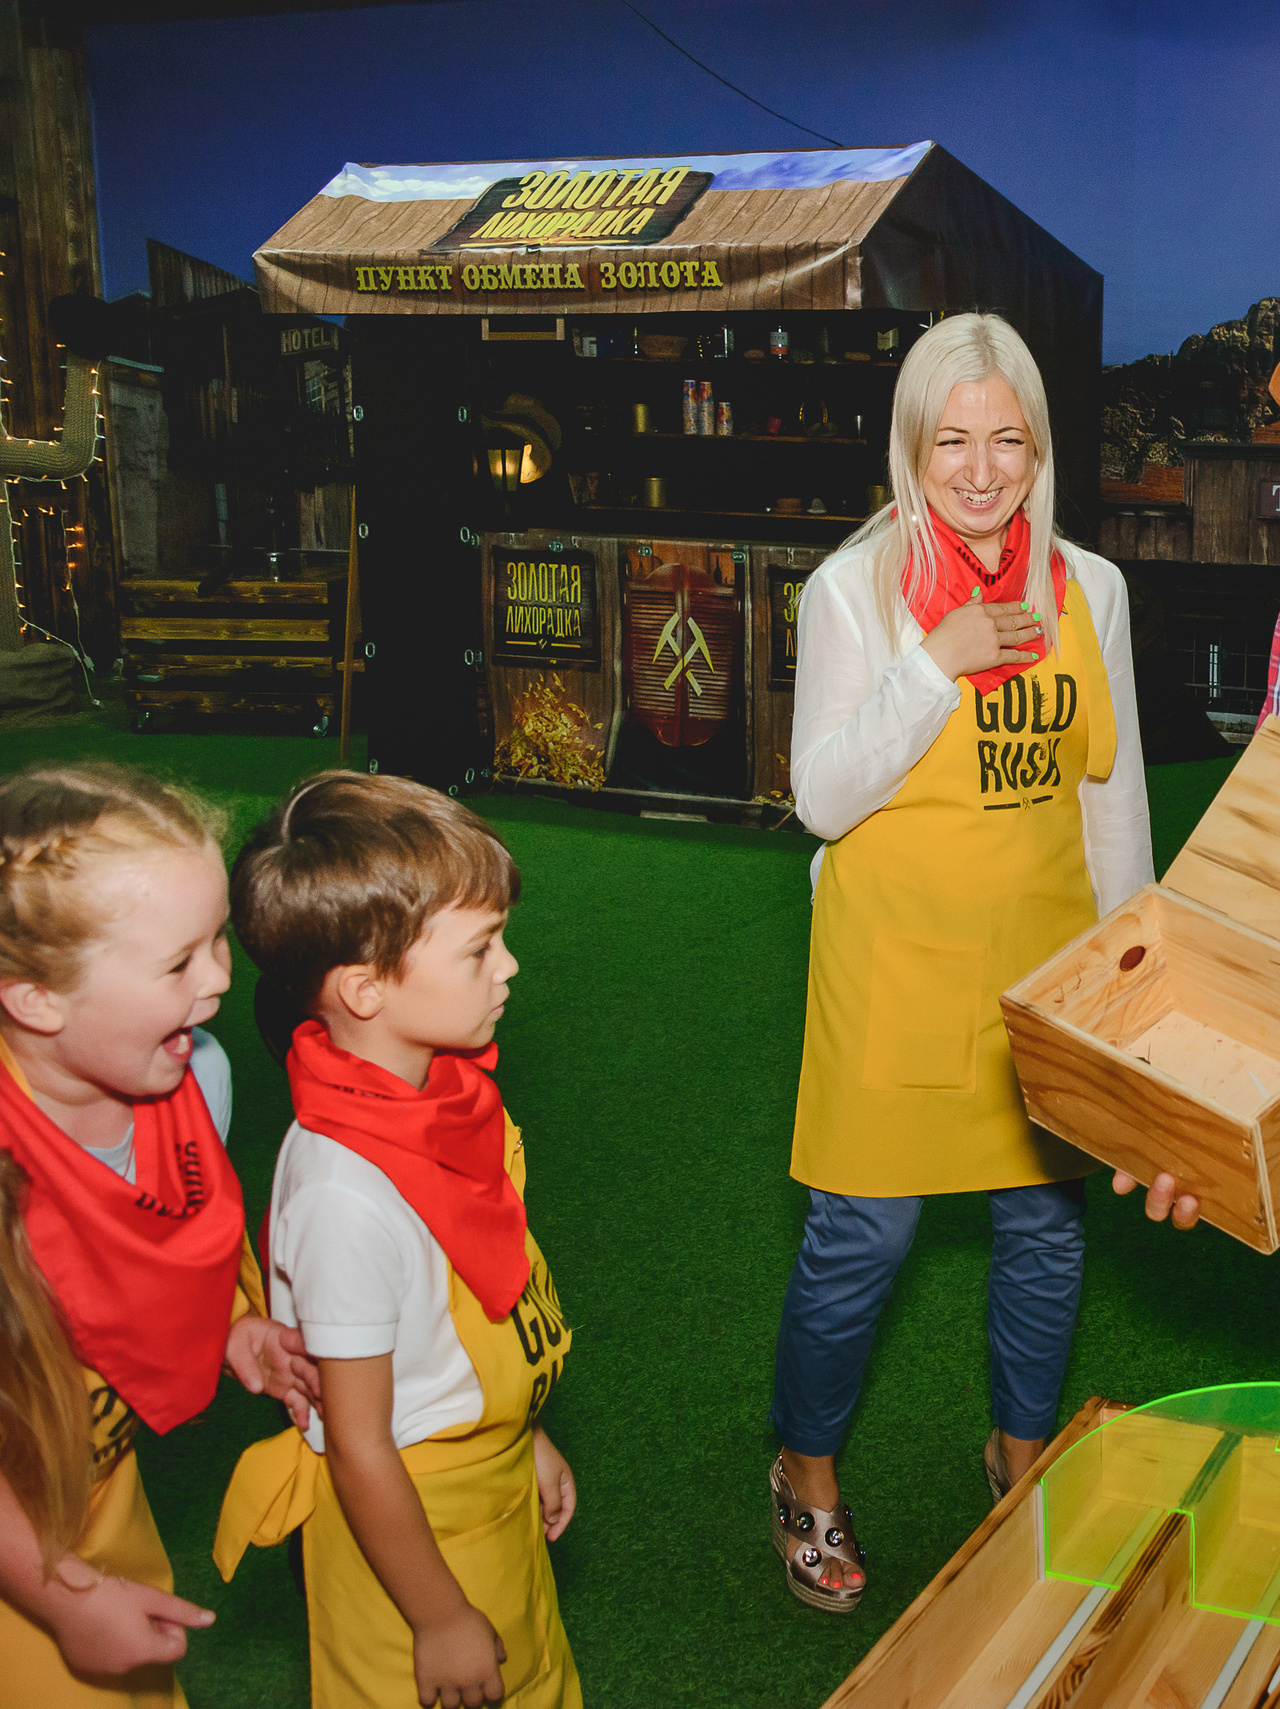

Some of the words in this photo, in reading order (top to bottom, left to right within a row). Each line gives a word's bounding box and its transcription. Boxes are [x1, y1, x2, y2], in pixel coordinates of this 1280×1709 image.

[501, 165, 692, 210] ЗОЛОТАЯ
[469, 207, 656, 239] ЛИХОРАДКА
[355, 265, 452, 292] ПУНКТ
[461, 263, 585, 291] ОБМЕНА
[600, 260, 724, 289] ЗОЛОТА
[281, 327, 331, 353] HOTEL
[506, 562, 581, 603] ЗОЛОТАЯ
[505, 605, 581, 638] ЛИХОРАДКА
[975, 674, 1078, 734] GOLD
[978, 738, 1062, 793] RUSH
